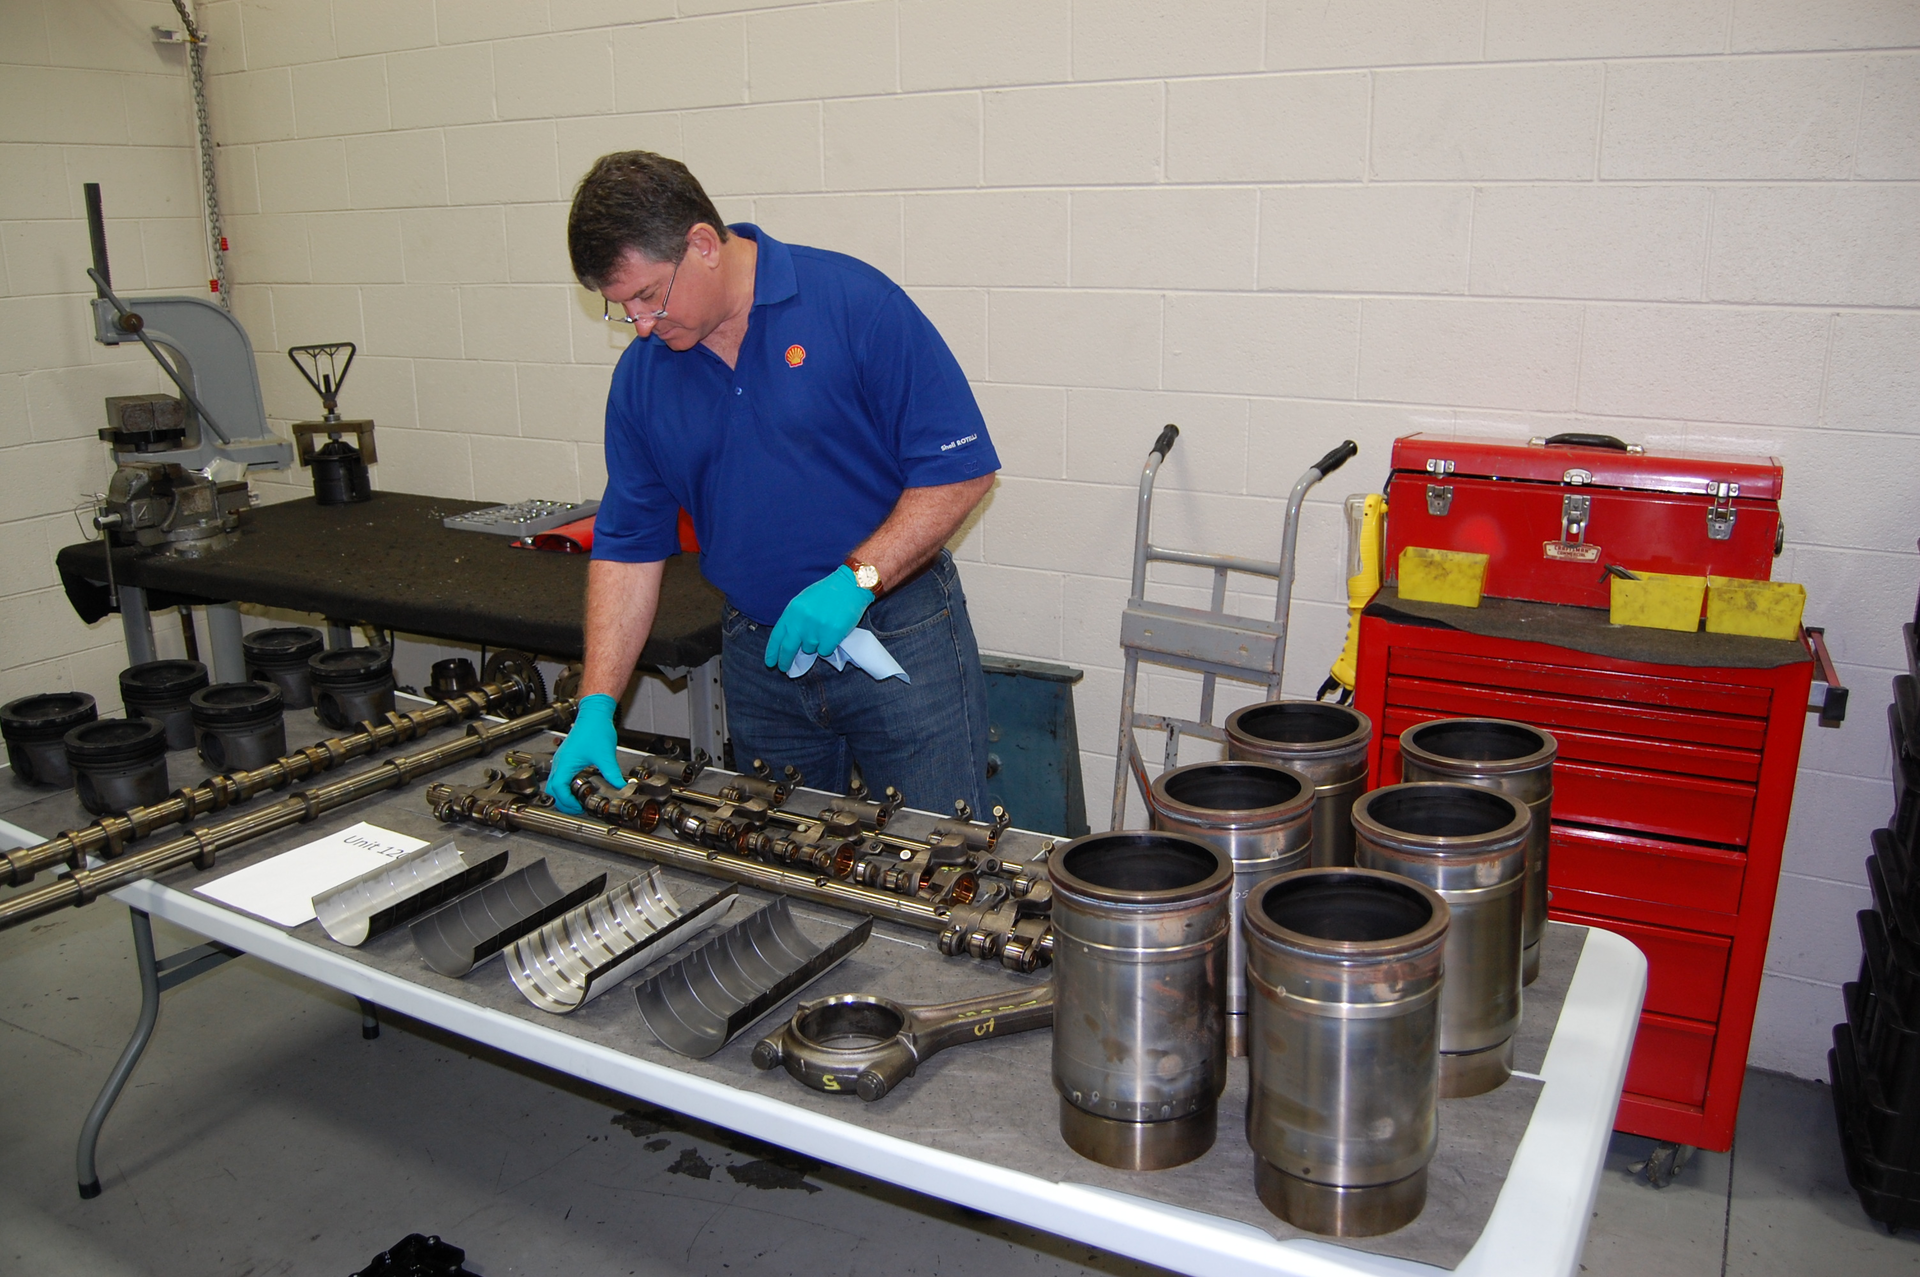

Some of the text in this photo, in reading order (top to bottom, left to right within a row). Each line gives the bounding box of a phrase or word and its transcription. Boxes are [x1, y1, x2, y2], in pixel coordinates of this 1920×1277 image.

[343, 834, 380, 851] Unit
[974, 1017, 995, 1037] 5
[822, 1075, 841, 1090] 5
